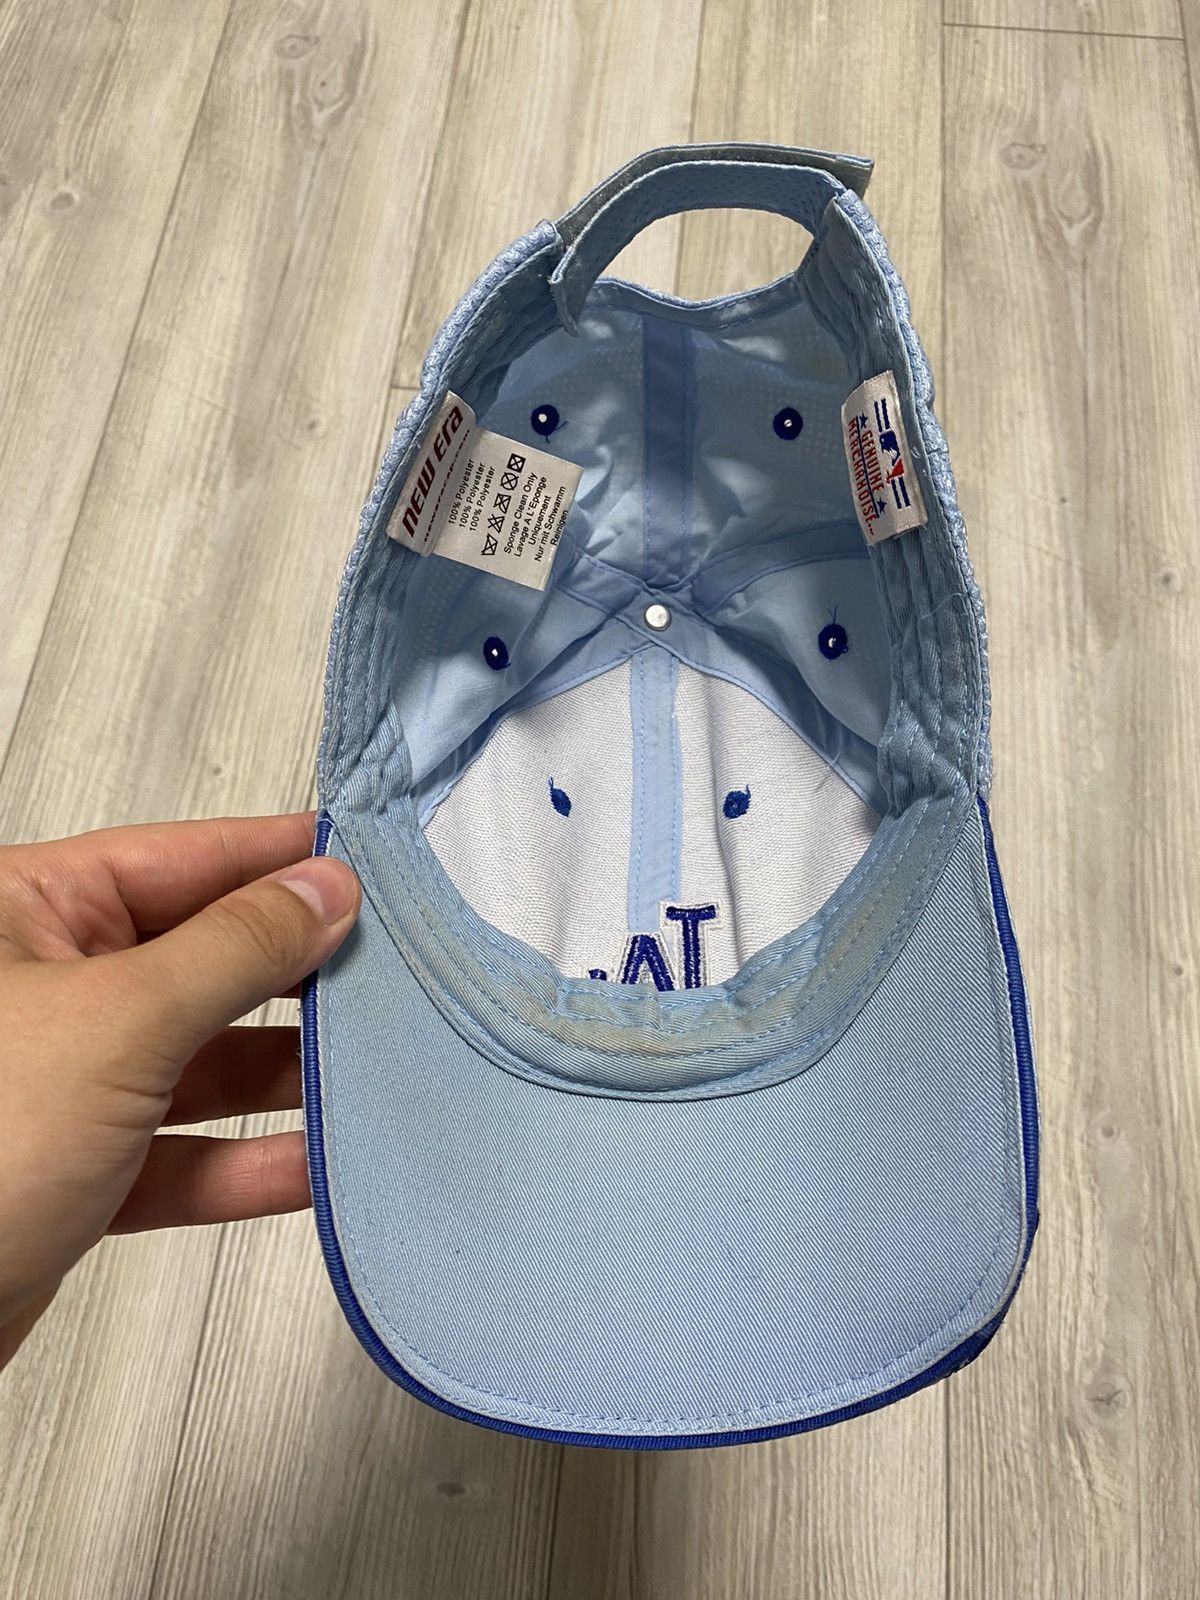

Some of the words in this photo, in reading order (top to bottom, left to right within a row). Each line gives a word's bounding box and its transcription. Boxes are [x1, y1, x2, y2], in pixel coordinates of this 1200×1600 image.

[448, 501, 462, 525] 100%
[456, 458, 475, 503] Polyester
[861, 430, 885, 492] GENUINE
[459, 506, 472, 529] 100%
[466, 462, 485, 506] Polyester
[469, 509, 482, 532] 100%
[477, 465, 496, 509] Polyester
[503, 520, 520, 554] Sponge
[514, 494, 528, 521] Clean
[522, 472, 538, 495] Only
[527, 494, 552, 546] Uniquement
[534, 545, 545, 562] Nur
[541, 529, 550, 545] mit
[546, 485, 567, 530] Schwamm
[550, 509, 569, 546] Reinigen
[514, 525, 530, 557] Lavage
[524, 516, 532, 525] A
